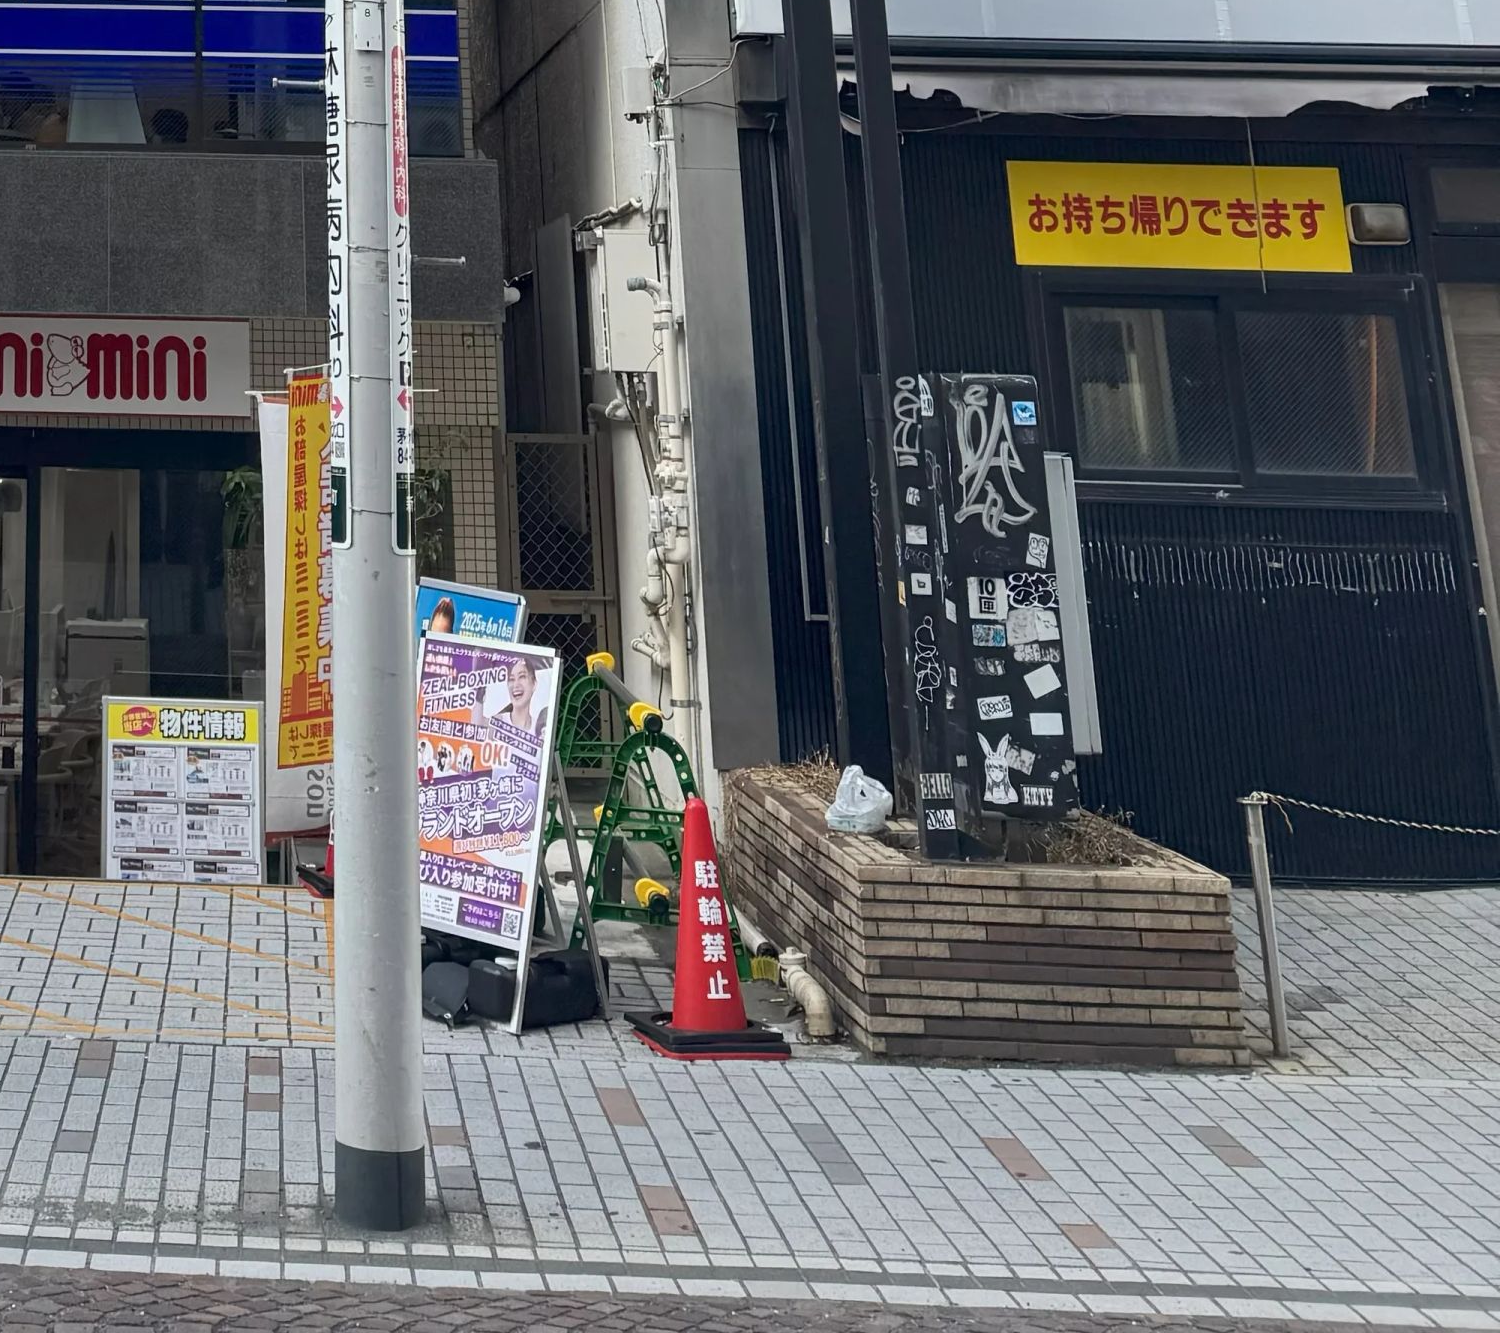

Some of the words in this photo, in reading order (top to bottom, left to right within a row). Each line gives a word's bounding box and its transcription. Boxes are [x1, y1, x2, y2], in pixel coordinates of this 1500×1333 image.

[365, 8, 371, 18] 8
[1027, 192, 1325, 240] お持ち帰りできます
[86, 331, 208, 402] mini
[423, 677, 457, 696] ZEAL
[458, 667, 507, 690] BOXING
[424, 691, 476, 714] FITNESS
[159, 708, 246, 741] 物件情報
[419, 798, 535, 841] ランドオープン
[694, 859, 733, 1001] 駐輪禁止
